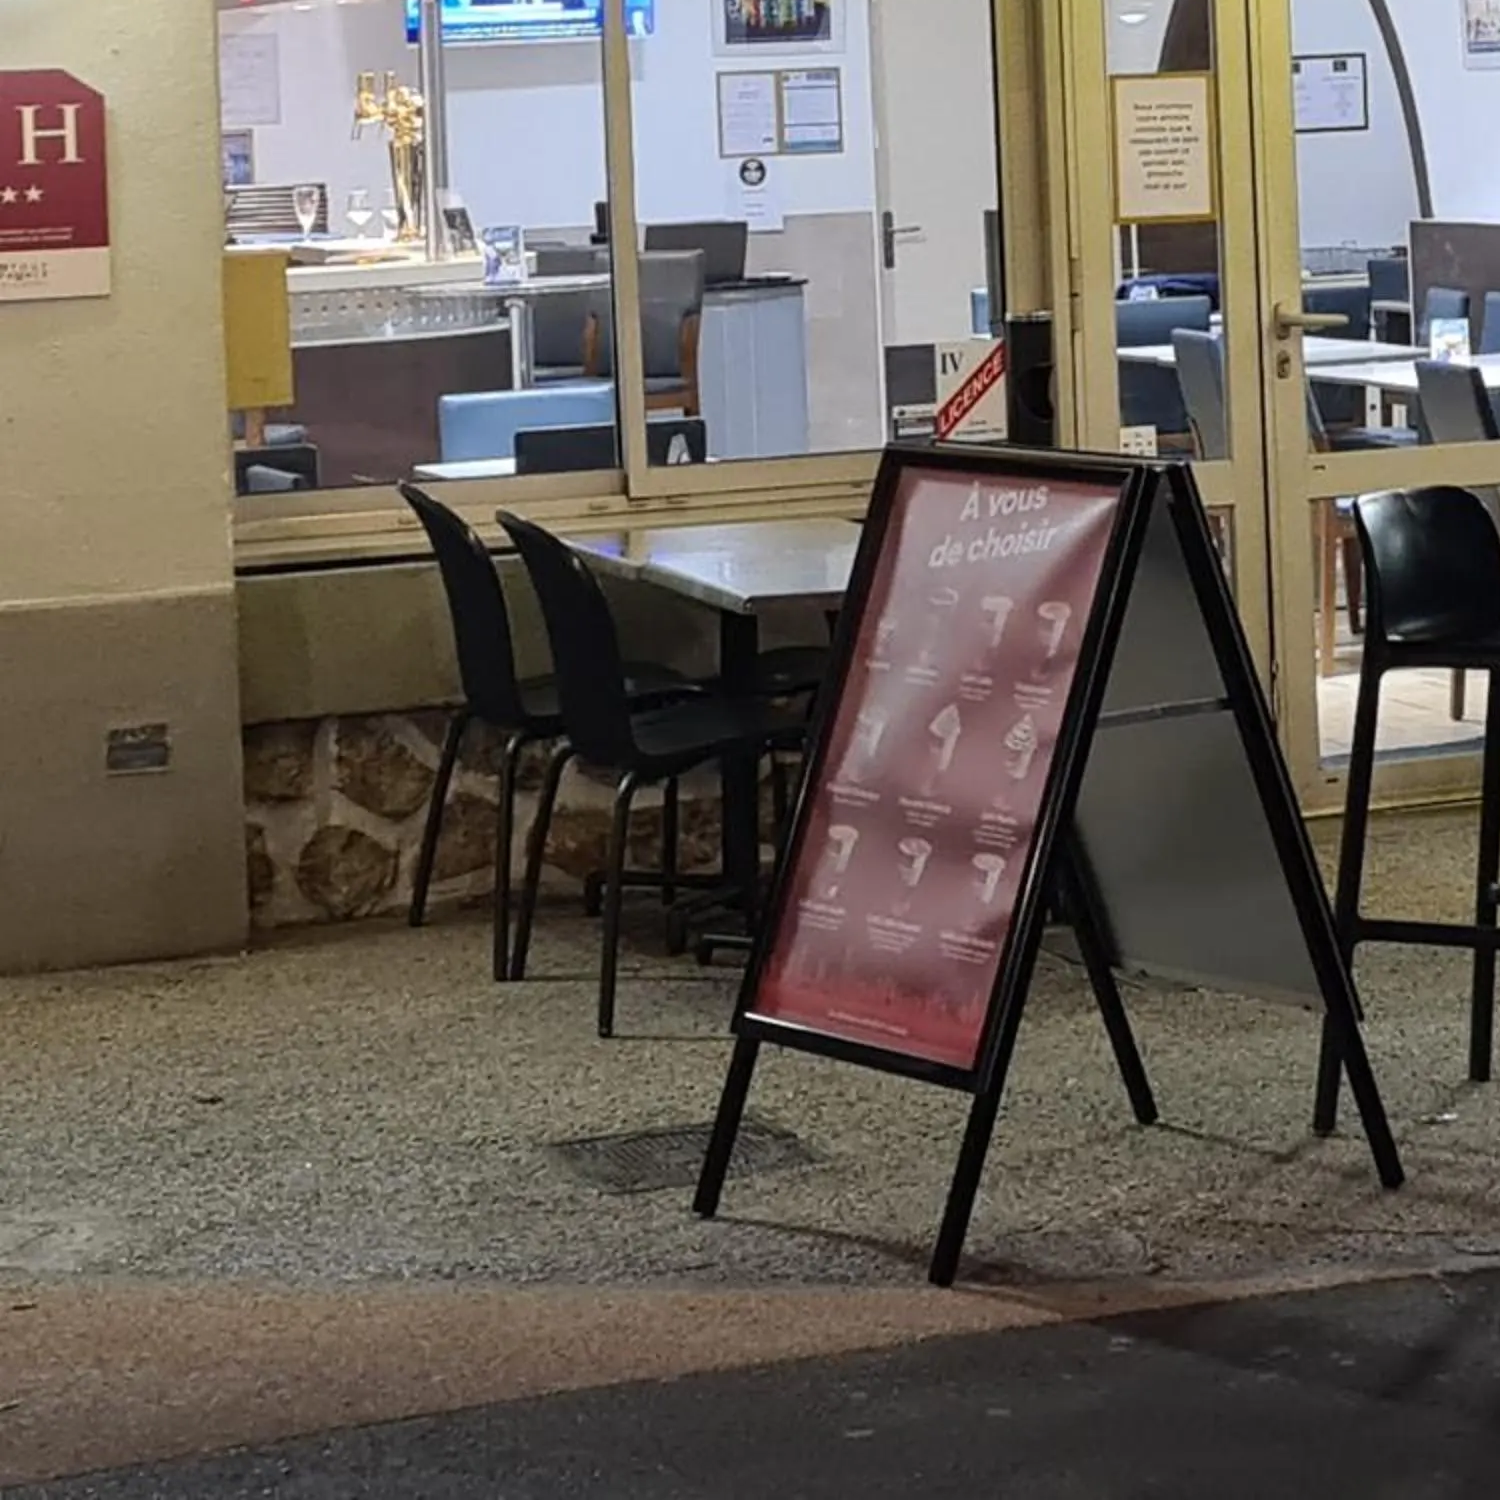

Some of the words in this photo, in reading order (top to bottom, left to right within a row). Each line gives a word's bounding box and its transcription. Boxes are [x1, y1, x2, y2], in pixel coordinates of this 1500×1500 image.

[15, 103, 86, 165] H
[941, 350, 965, 376] IV
[939, 346, 1005, 434] LICENCE
[988, 485, 1049, 518] vous
[927, 534, 964, 568] de
[966, 518, 1058, 562] choisir
